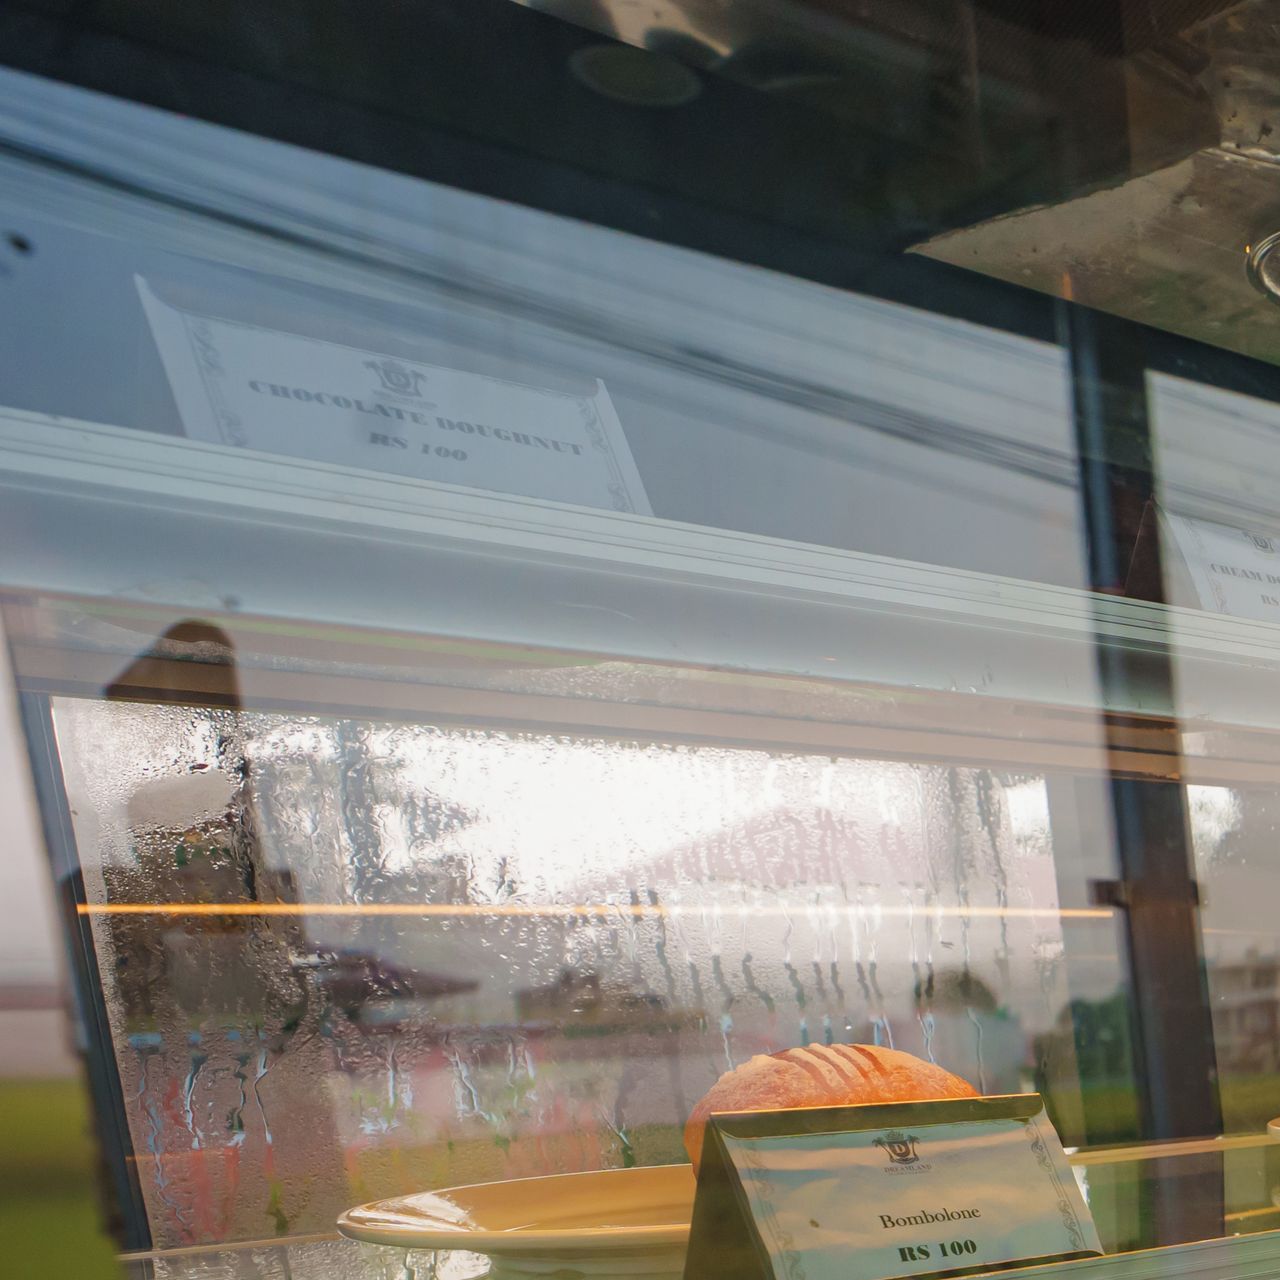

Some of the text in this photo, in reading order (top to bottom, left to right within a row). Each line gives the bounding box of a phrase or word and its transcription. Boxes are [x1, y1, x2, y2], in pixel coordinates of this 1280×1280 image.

[248, 380, 429, 427] CHOCOLATE
[437, 416, 585, 457] DOUGHNUT
[370, 432, 468, 462] RS 100
[1209, 562, 1262, 582] CREAM
[884, 1164, 931, 1172] DREAMLAND
[878, 1207, 982, 1229] Bombolone
[898, 1239, 978, 1262] RS 100
